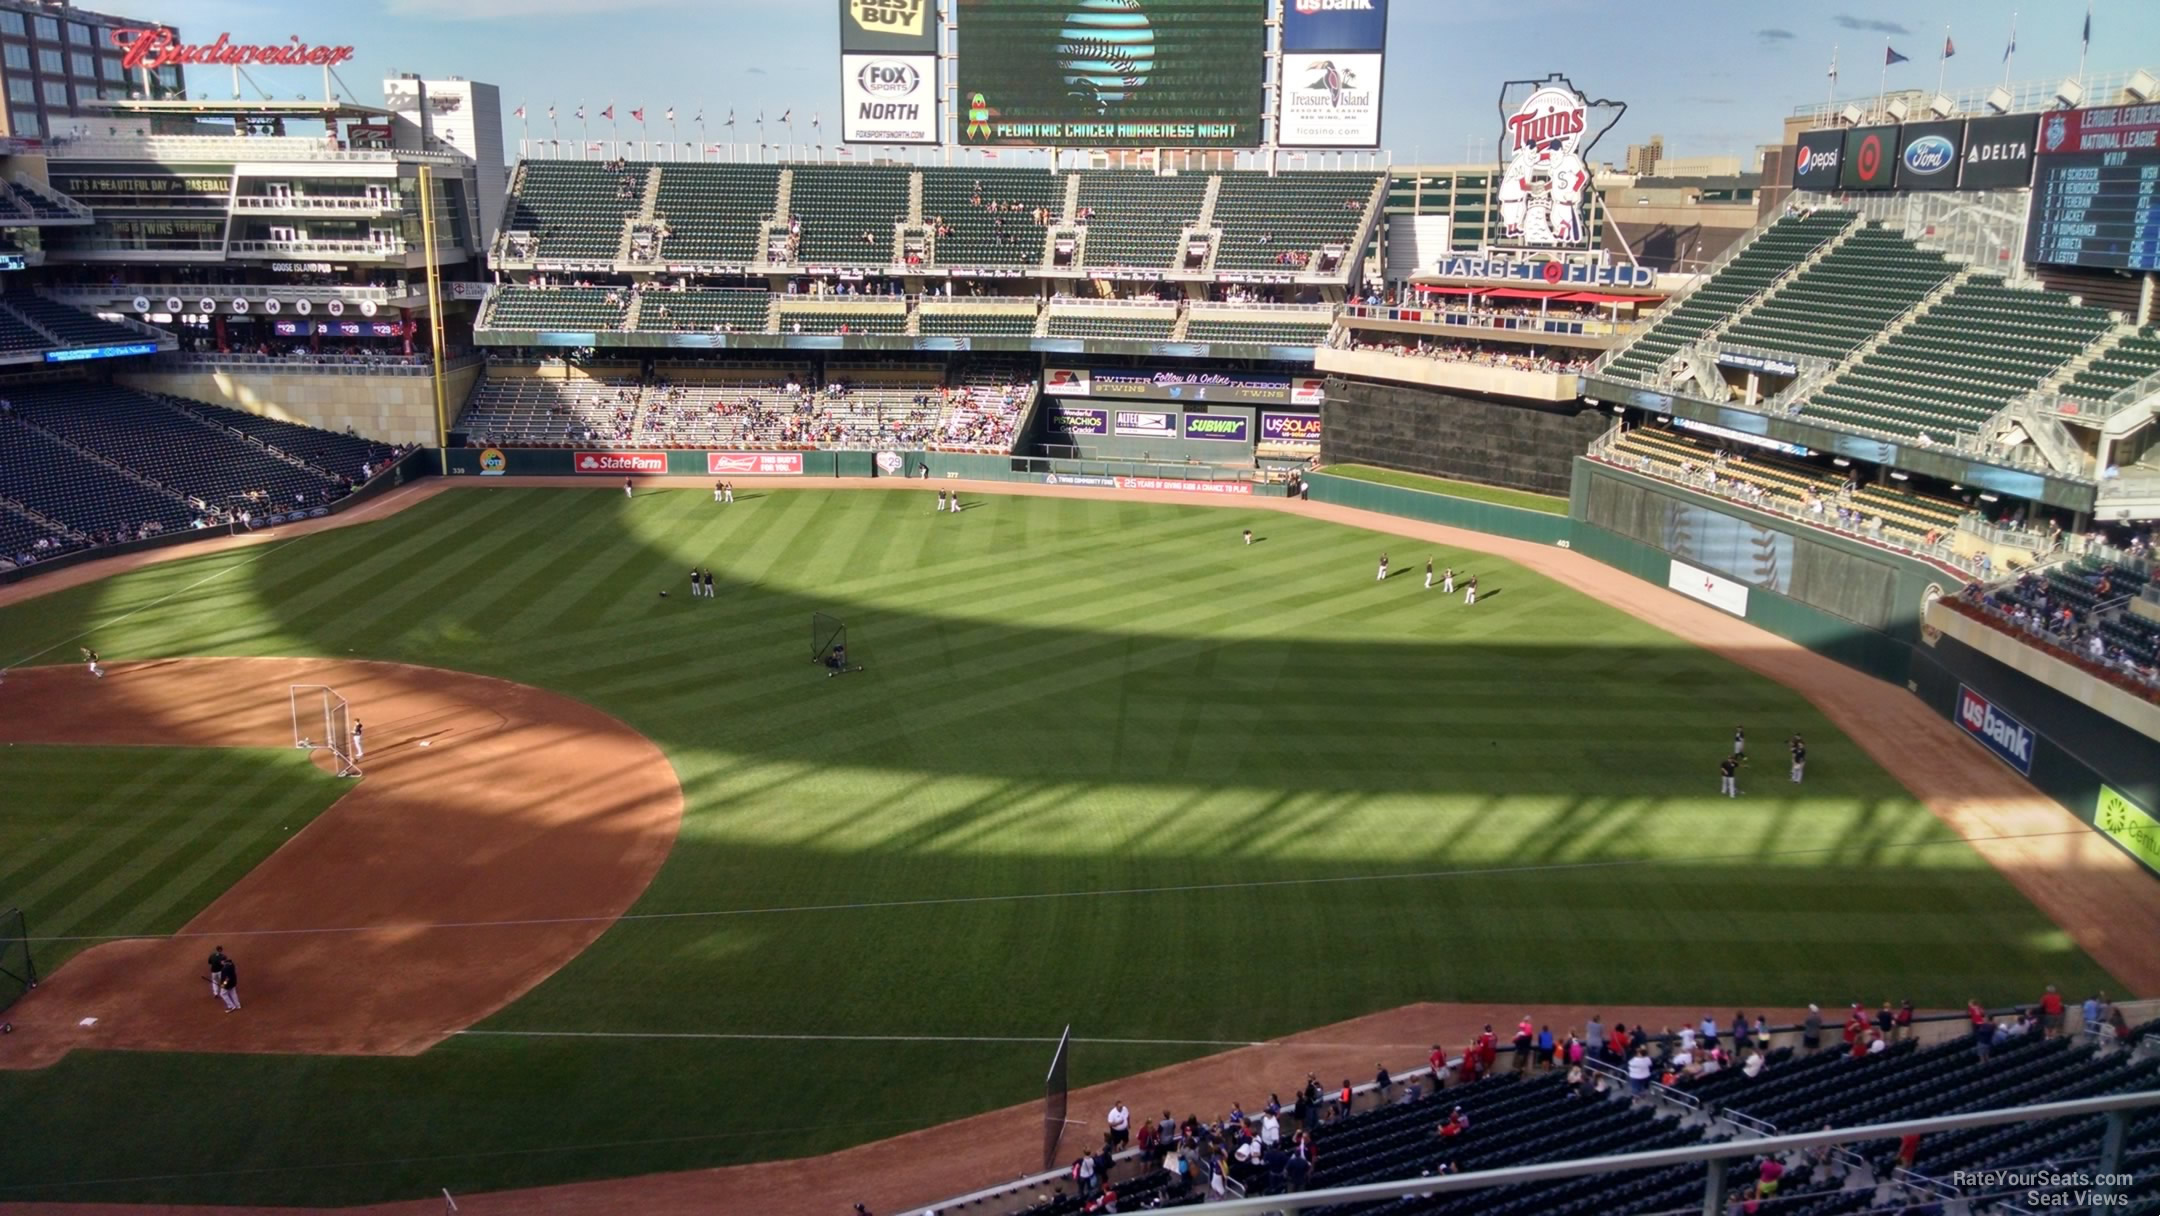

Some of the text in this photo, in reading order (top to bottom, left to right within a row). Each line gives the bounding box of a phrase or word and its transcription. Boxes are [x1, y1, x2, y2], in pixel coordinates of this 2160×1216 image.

[862, 8, 916, 26] BUY
[111, 28, 354, 69] Budweiser
[870, 67, 906, 83] FOX
[1290, 91, 1369, 106] Treasure Island
[859, 102, 919, 120] NORTH
[2080, 108, 2118, 128] LEAGUE
[856, 130, 925, 138] FOXSPORTSNORTH.COM
[998, 124, 1236, 138] PEDIATRIC CANCER AWARENESS NIGHT
[1508, 106, 1584, 151] Twins
[2080, 131, 2158, 150] NATIONAL LEAGUE
[1912, 141, 1944, 167] Ford
[1981, 143, 2027, 160] DELTA
[1810, 148, 1838, 171] pepsi
[100, 180, 150, 191] BEAUTIFUL
[151, 180, 167, 190] DAY
[185, 181, 229, 191] BASEBALL
[112, 222, 129, 232] THIS
[141, 223, 173, 235] TWINS
[175, 224, 216, 233] TERRITORY
[272, 263, 332, 273] GOOSE ISLAND PUB
[1438, 258, 1652, 286] TARGET FIELD
[285, 324, 295, 332] 29
[318, 325, 327, 333] 29
[349, 325, 359, 333] 29
[381, 325, 391, 333] 29
[1095, 376, 1151, 384] TWITTER
[1153, 372, 1230, 385] Follow Us Online
[1096, 384, 1145, 392] @TWINS
[1230, 381, 1290, 390] FACEBOOK
[1054, 416, 1102, 426] PISTACHIOS
[1118, 413, 1138, 424] ALTEC
[1188, 420, 1244, 433] SUBWAY
[889, 458, 900, 466] 29
[1124, 478, 1136, 488] 25
[1557, 540, 1570, 548] 403
